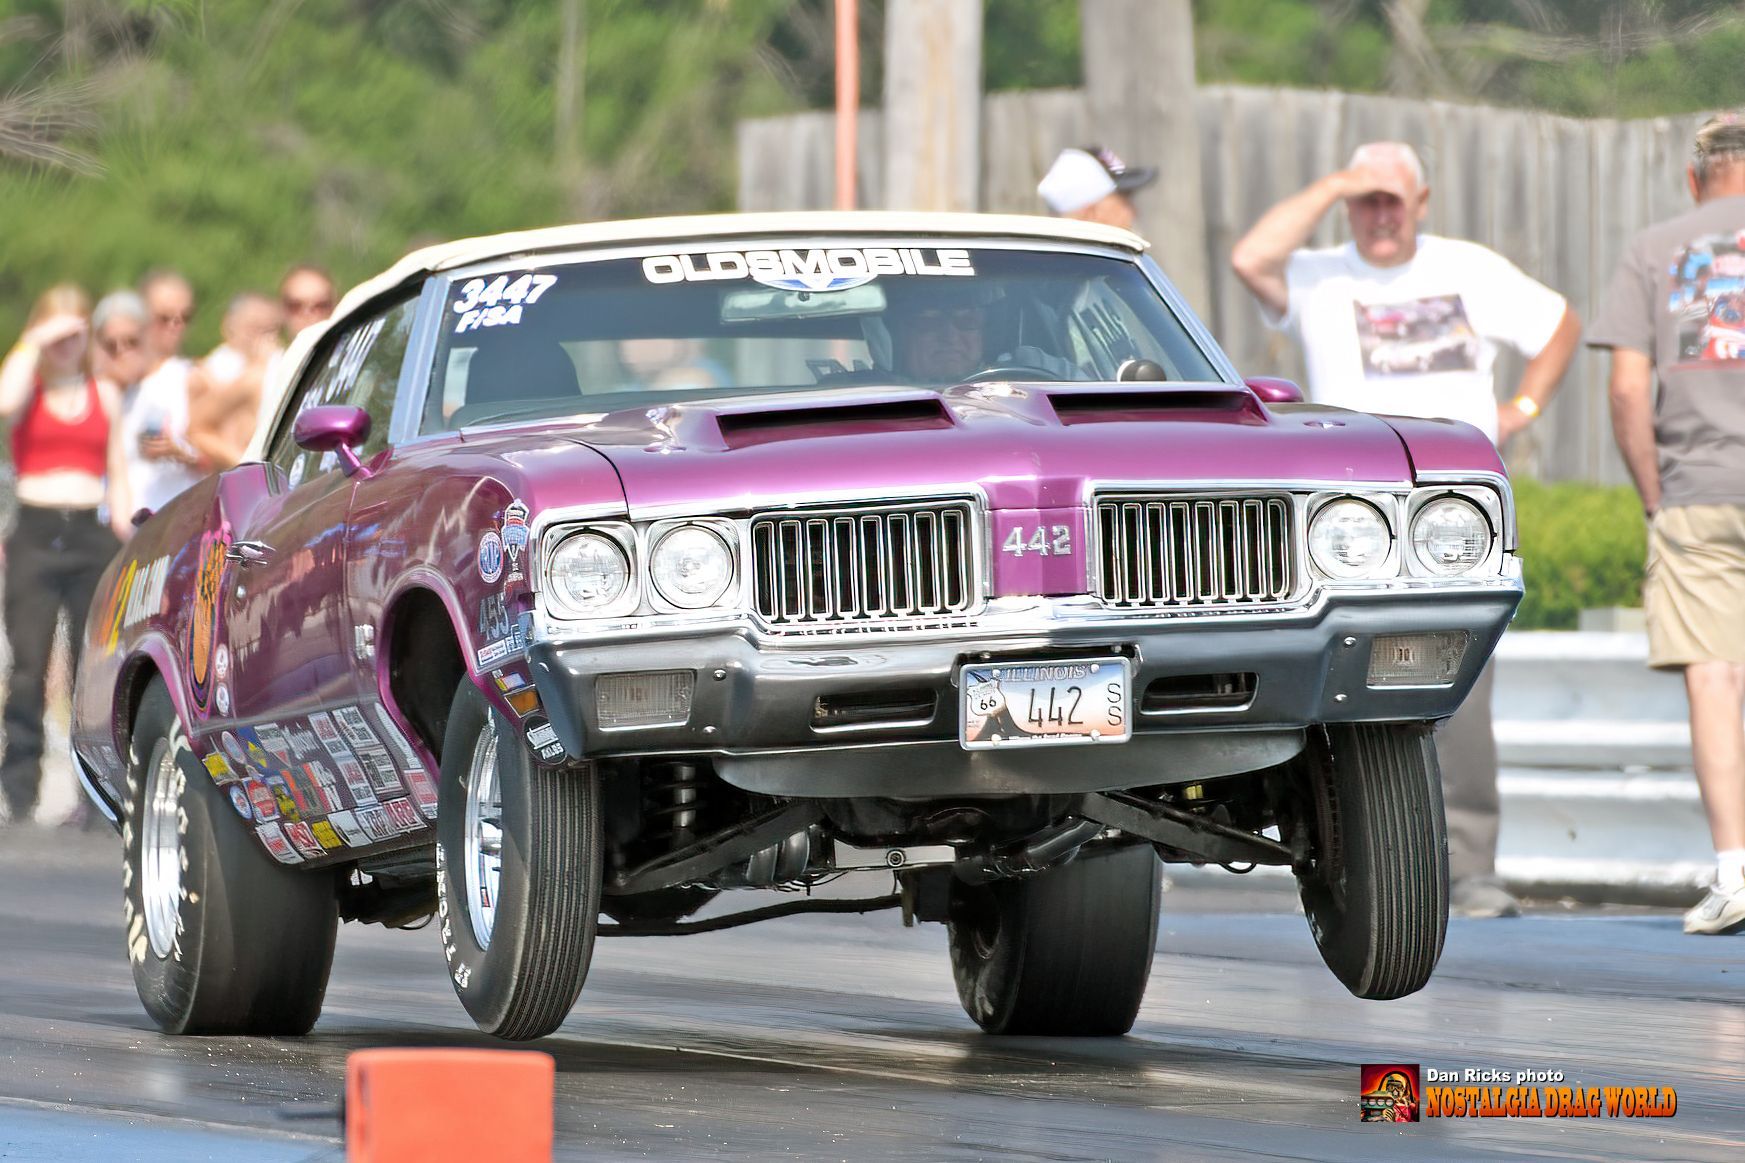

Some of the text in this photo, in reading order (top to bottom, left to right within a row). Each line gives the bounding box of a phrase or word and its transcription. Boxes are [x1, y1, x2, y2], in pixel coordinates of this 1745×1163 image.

[642, 248, 975, 284] OLDSMOBILE
[453, 273, 558, 314] 3447
[455, 305, 523, 333] F/SA
[1002, 525, 1072, 557] 442
[479, 592, 509, 641] 455
[1005, 664, 1088, 682] ILLINOIS
[980, 696, 997, 711] 66
[1028, 686, 1084, 728] 442
